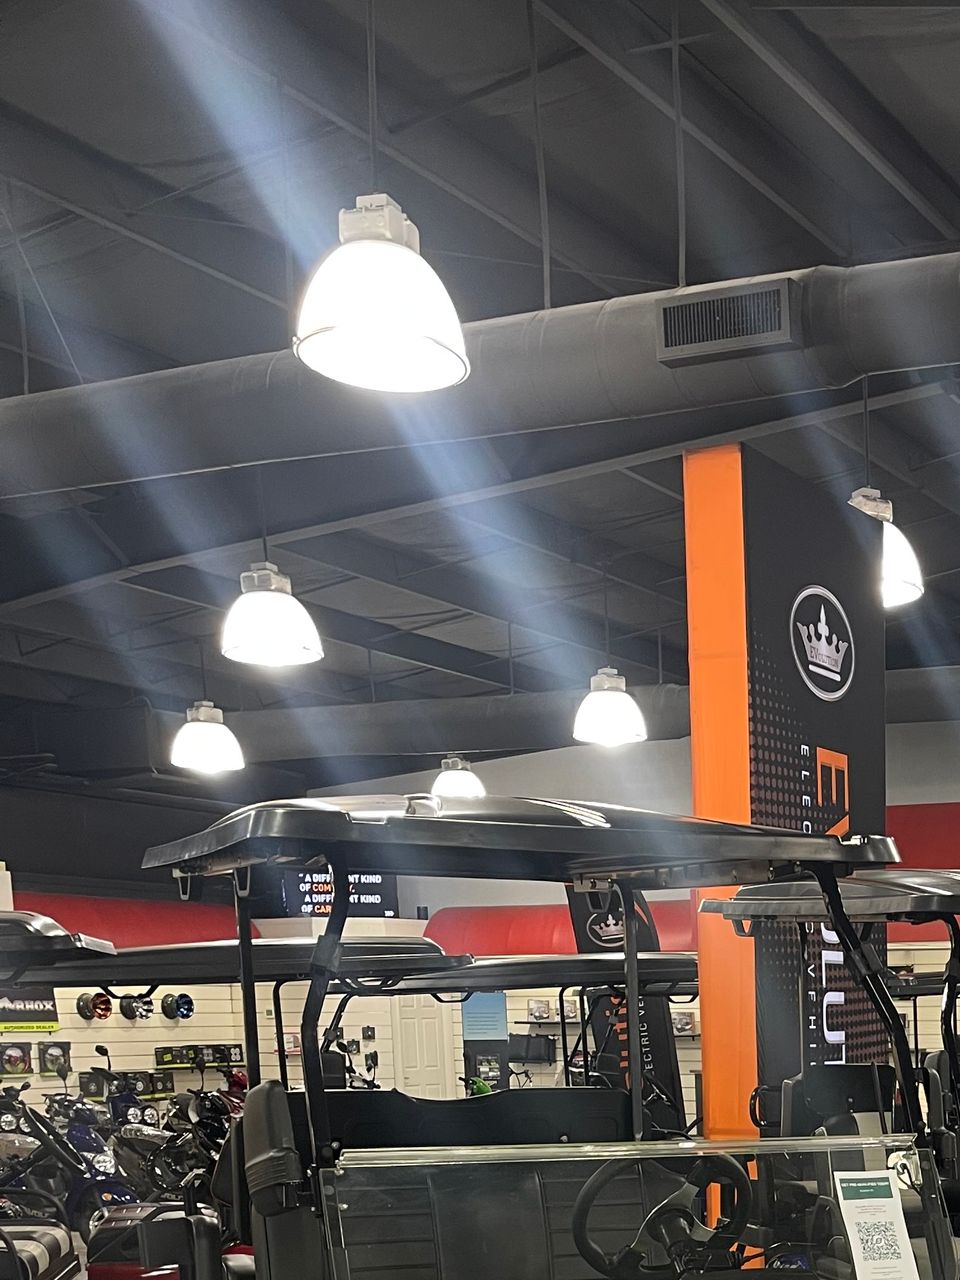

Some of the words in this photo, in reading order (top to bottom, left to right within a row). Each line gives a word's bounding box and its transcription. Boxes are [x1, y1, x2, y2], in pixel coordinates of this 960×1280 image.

[312, 874, 360, 883] DIFFNT
[360, 874, 382, 883] KIND
[299, 883, 311, 892] OF
[304, 894, 311, 903] A
[312, 894, 360, 903] DIFFNT
[360, 894, 381, 903] KIND
[301, 905, 313, 913] OF
